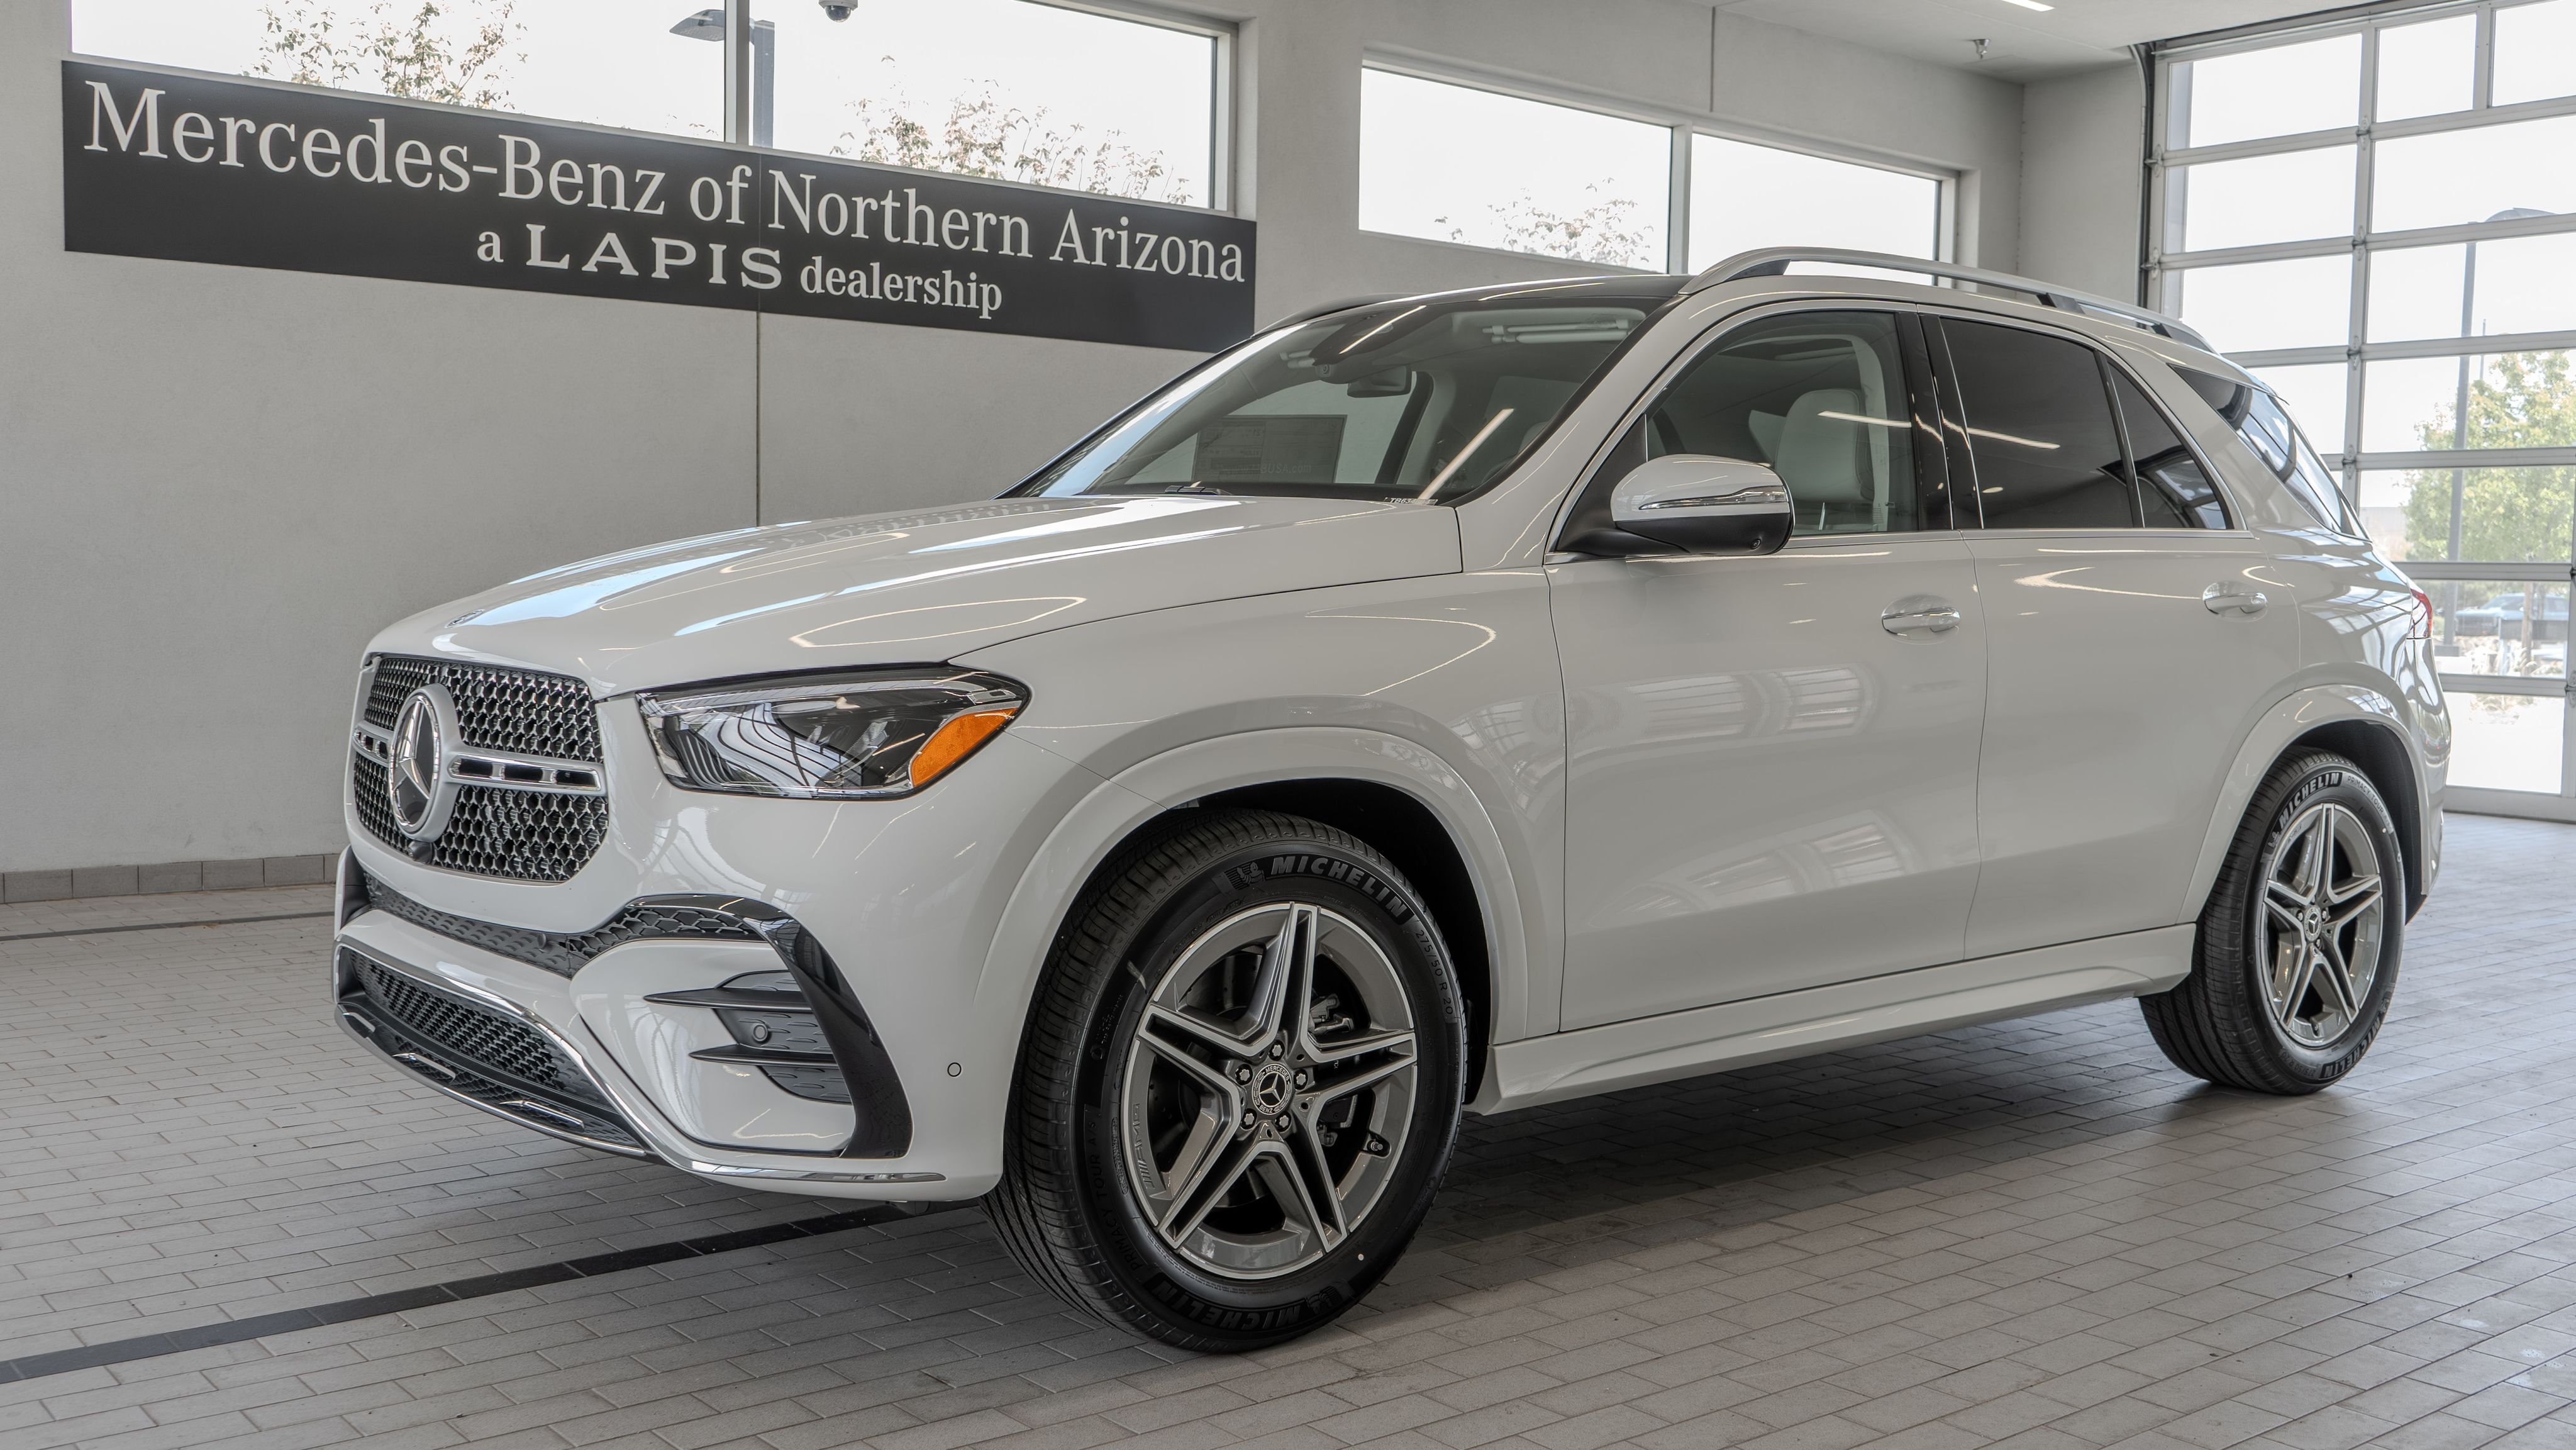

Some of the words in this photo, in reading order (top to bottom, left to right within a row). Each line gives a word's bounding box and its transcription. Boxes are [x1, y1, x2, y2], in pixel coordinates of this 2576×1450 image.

[84, 81, 665, 215] Mercedes-Benz
[690, 165, 752, 225] of
[768, 169, 1031, 258] Northern
[1049, 208, 1245, 282] Arizona
[476, 231, 504, 263] a
[526, 223, 782, 290] LAPIS
[800, 256, 1002, 319] dealership
[2279, 772, 2340, 829] MICHELIN
[2347, 775, 2370, 795] PRIMACY
[2370, 795, 2384, 815] TOUR
[1271, 856, 1407, 918] MICHELIN
[1416, 930, 1443, 977] 275/50
[1439, 981, 1448, 991] R
[1443, 997, 1454, 1015] 20
[2323, 1017, 2381, 1078] MICHELIN
[1265, 1066, 1290, 1081] MERCEDES
[1258, 1105, 1274, 1113] BENZ
[1087, 1121, 1097, 1146] A/S
[1091, 1154, 1108, 1198] TOUR
[1102, 1208, 1145, 1272] PRIMACY
[1150, 1283, 1302, 1330] MICHELIN
